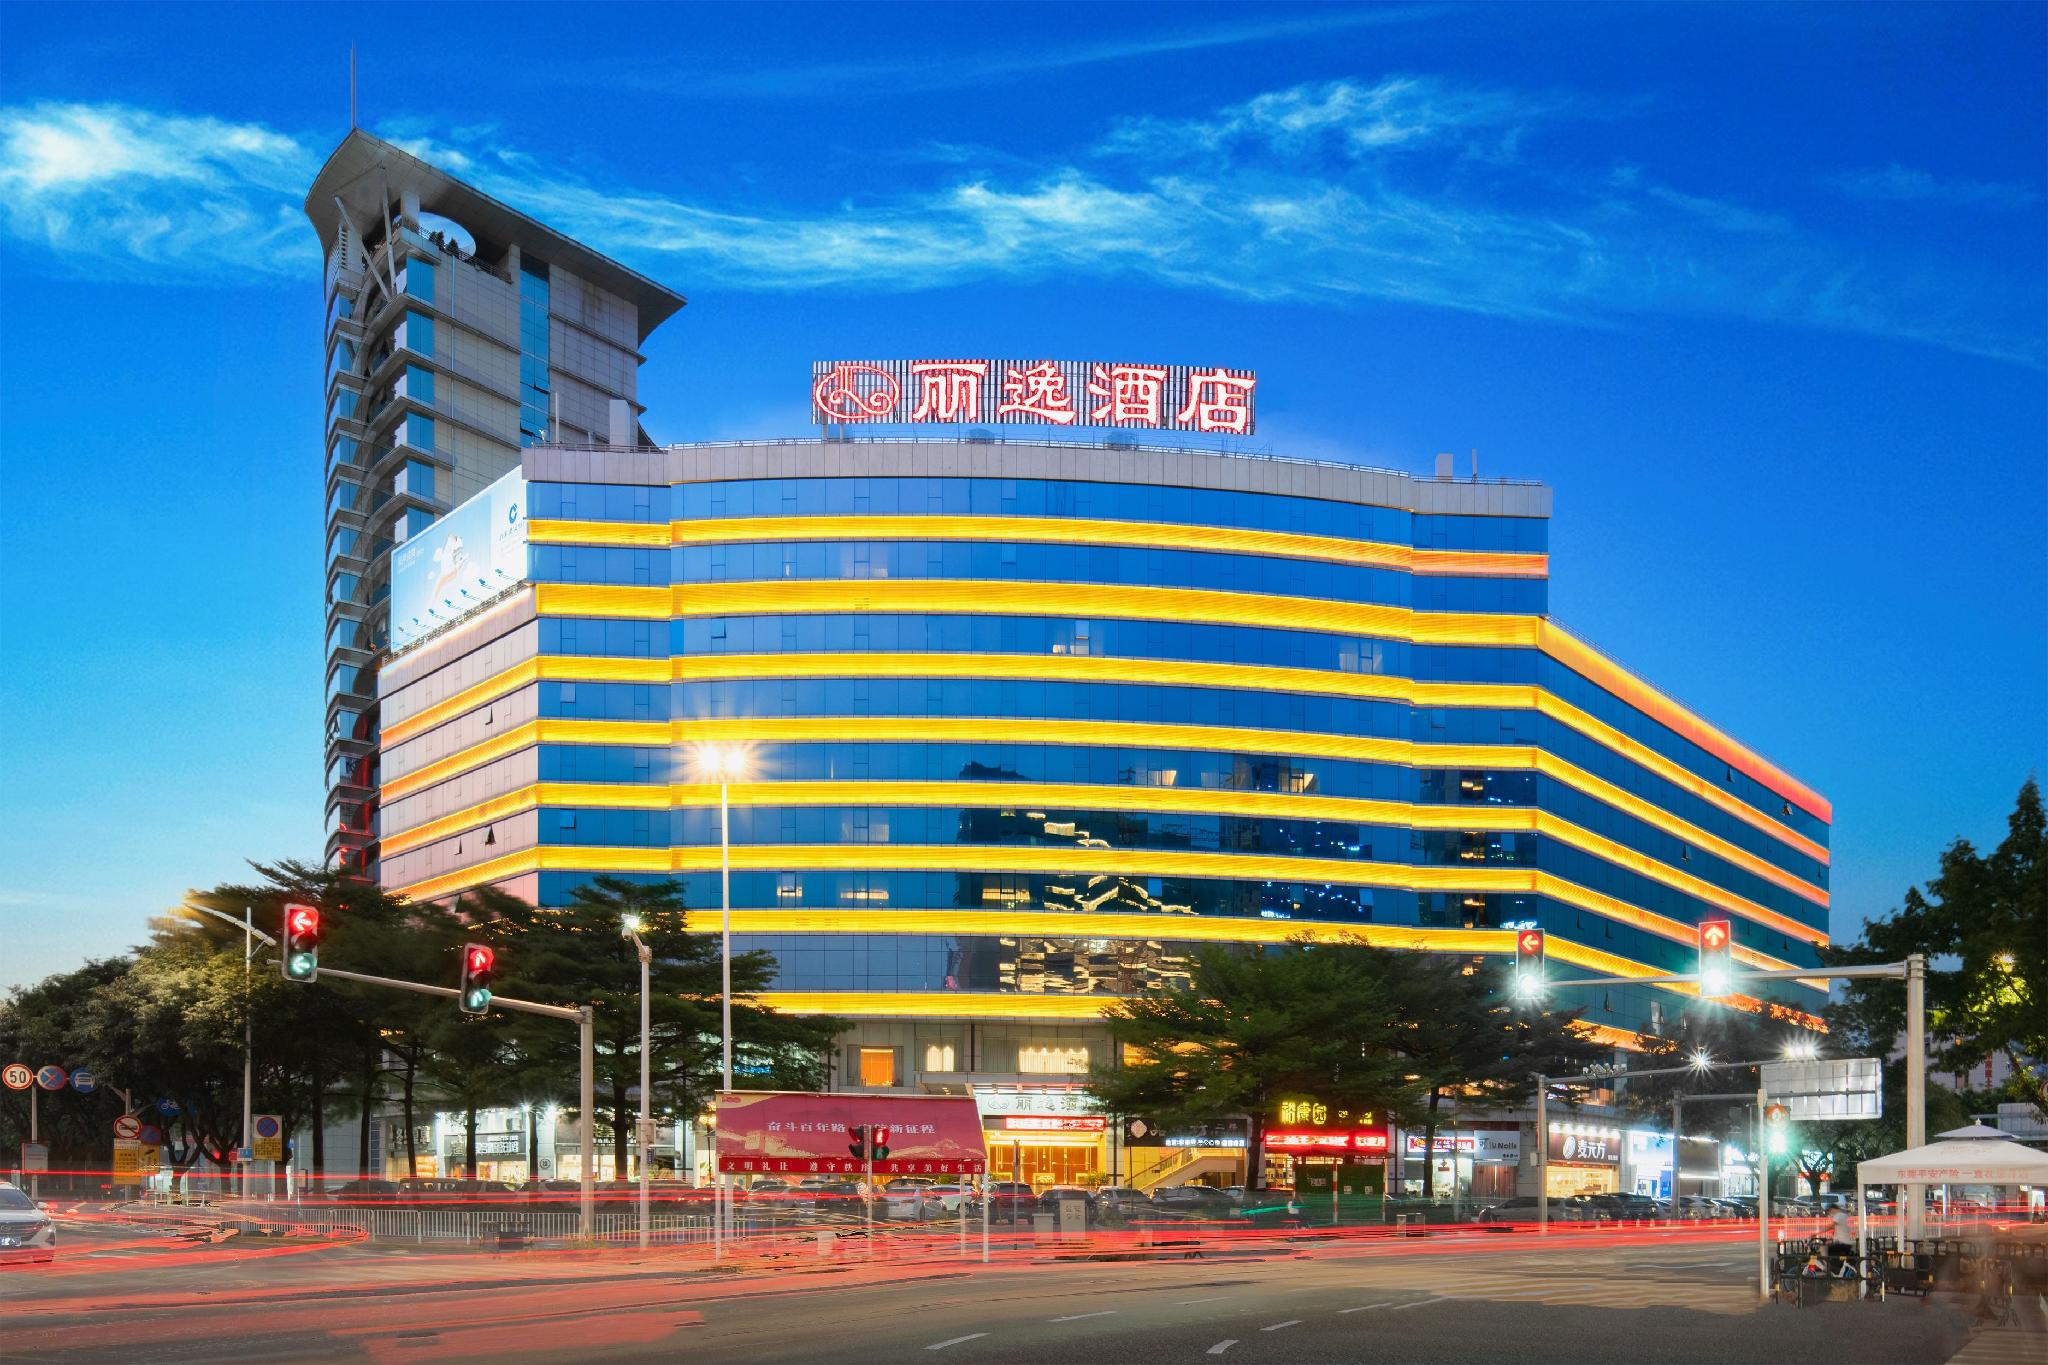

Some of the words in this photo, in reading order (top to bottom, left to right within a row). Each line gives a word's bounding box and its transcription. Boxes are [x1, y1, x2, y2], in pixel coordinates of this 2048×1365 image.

[912, 361, 1256, 433] 丽逸酒店
[9, 1070, 27, 1084] 50
[1015, 1095, 1088, 1112] 丽逸酒
[768, 1121, 845, 1133] 奋斗百年路
[859, 1123, 935, 1134] 新征程
[1577, 1139, 1607, 1159] 麦元方
[727, 1161, 788, 1171] 文明礼让
[809, 1161, 868, 1172] 遵守秩序
[890, 1163, 982, 1173] 共享美好生活
